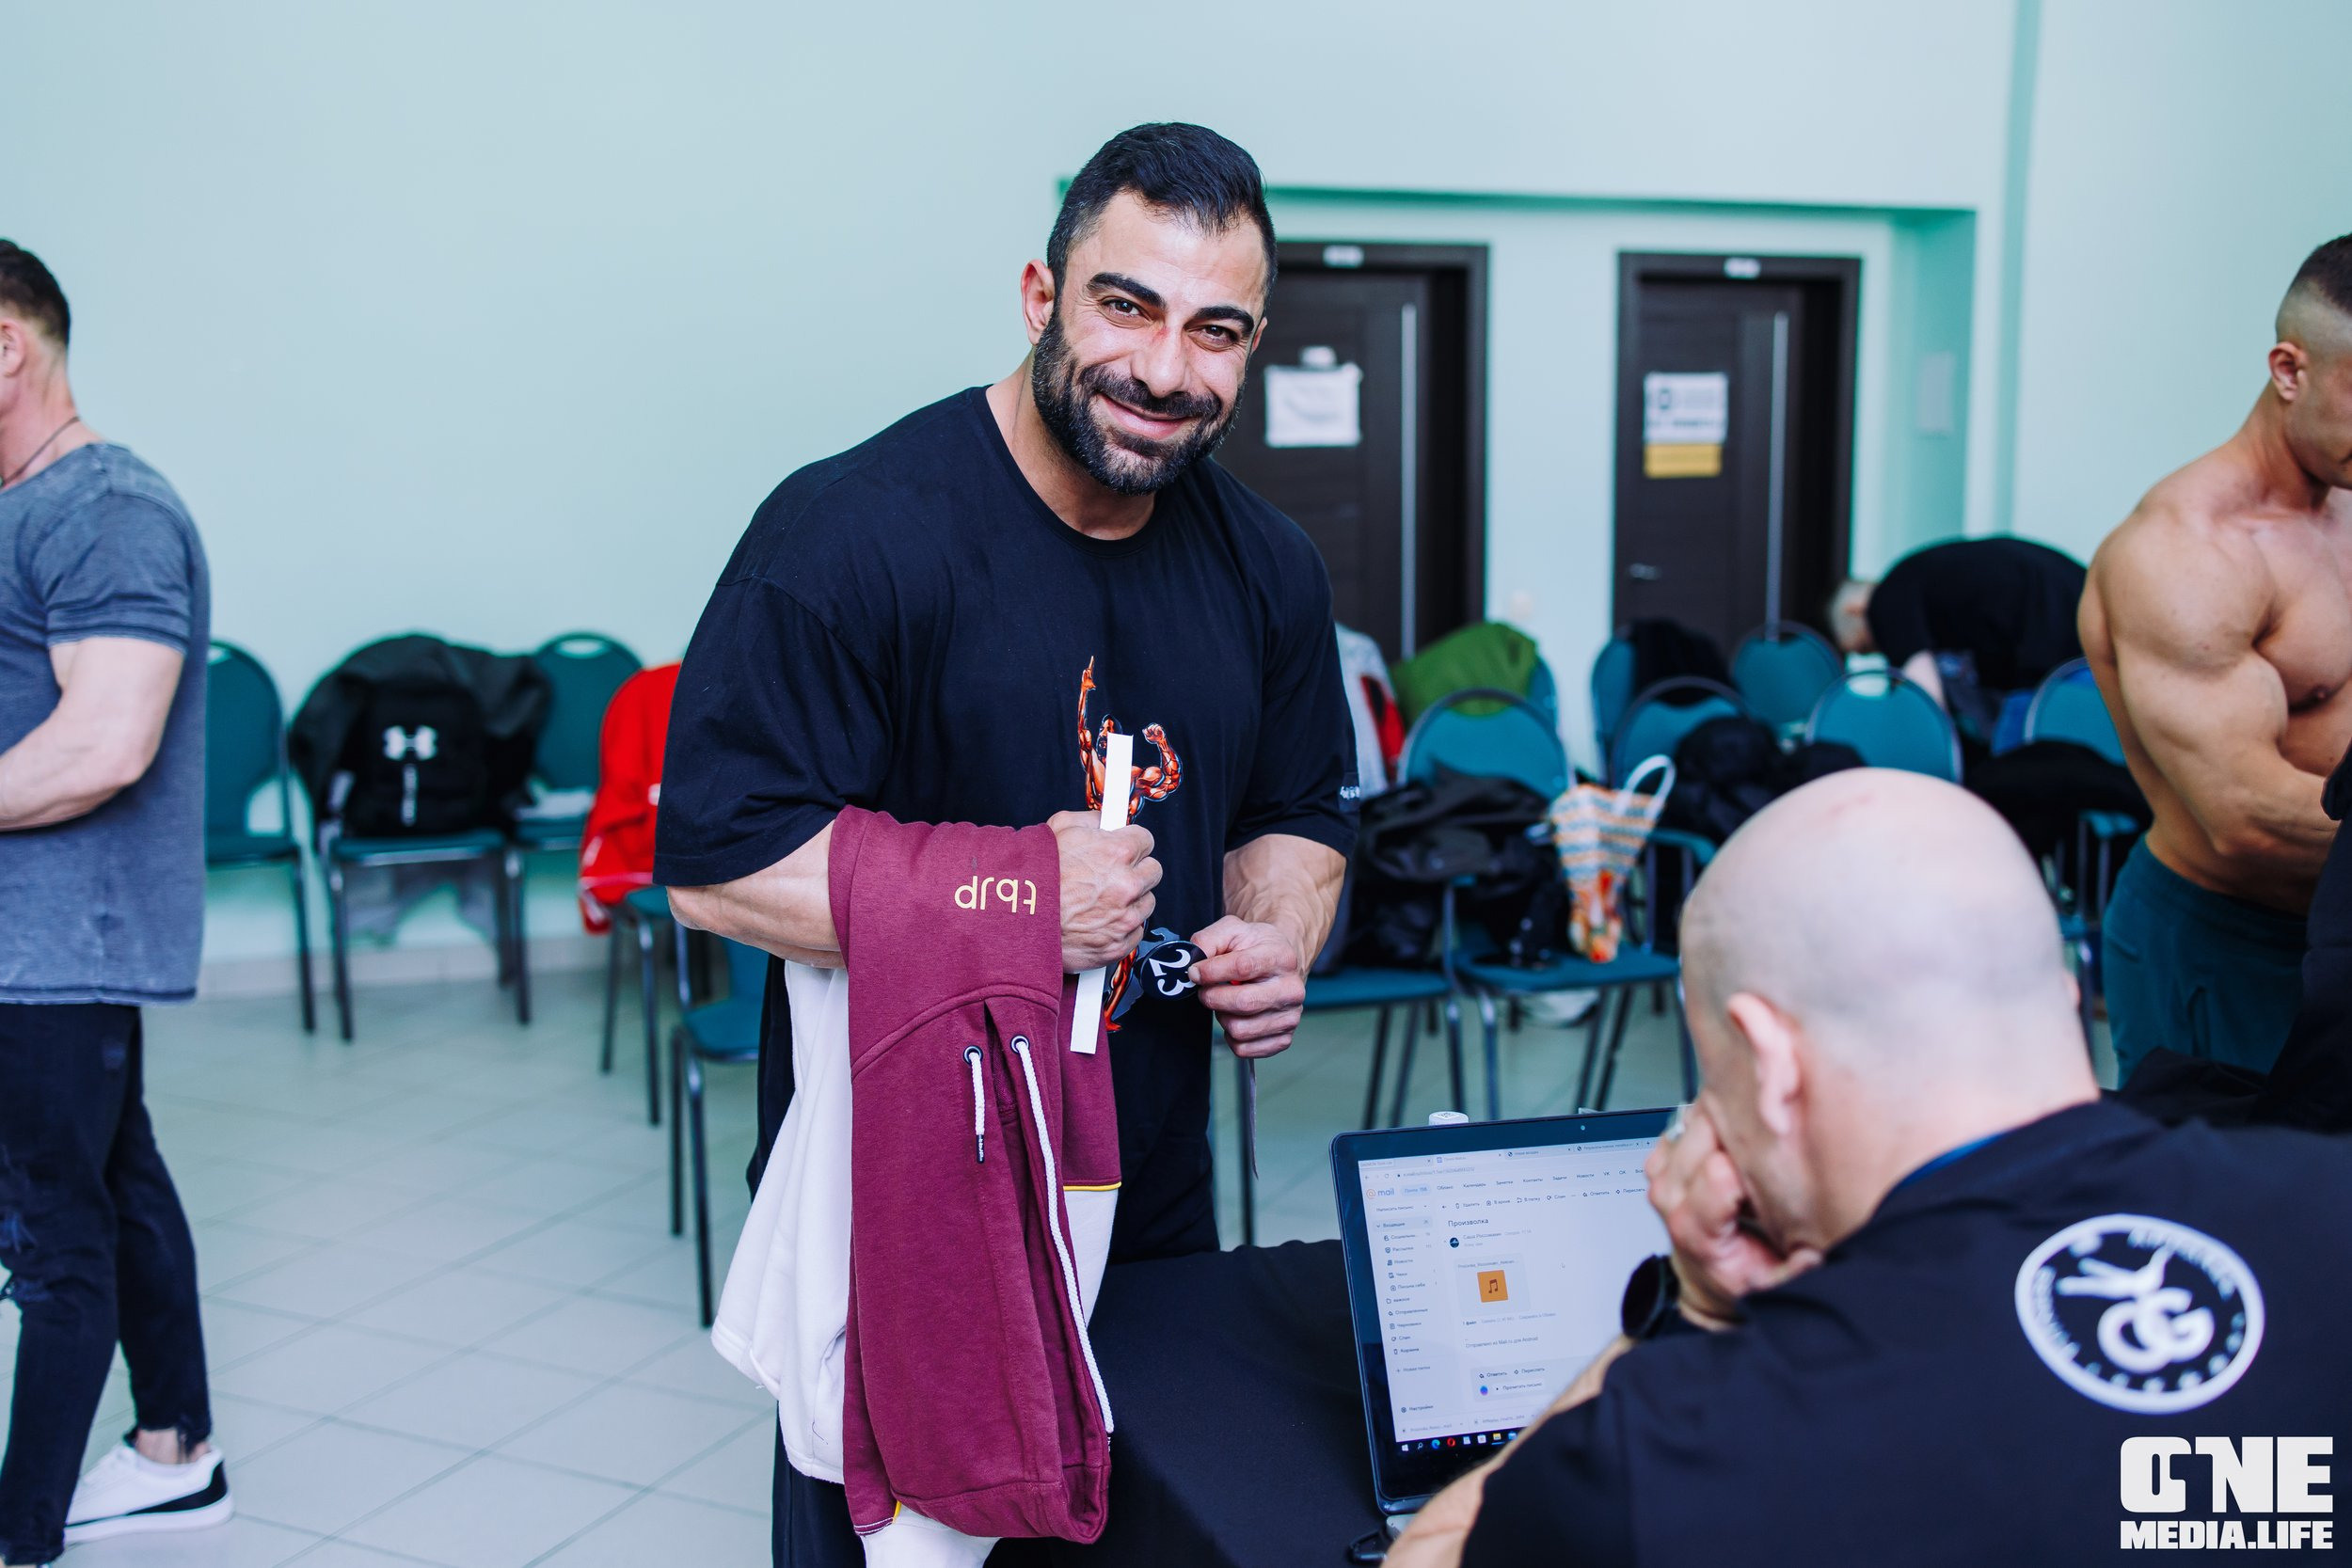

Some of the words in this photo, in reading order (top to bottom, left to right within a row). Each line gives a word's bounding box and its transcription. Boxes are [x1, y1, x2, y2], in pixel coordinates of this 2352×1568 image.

[1149, 949, 1196, 996] 23
[1377, 1188, 1395, 1196] mail
[1448, 1218, 1489, 1227] Произволка
